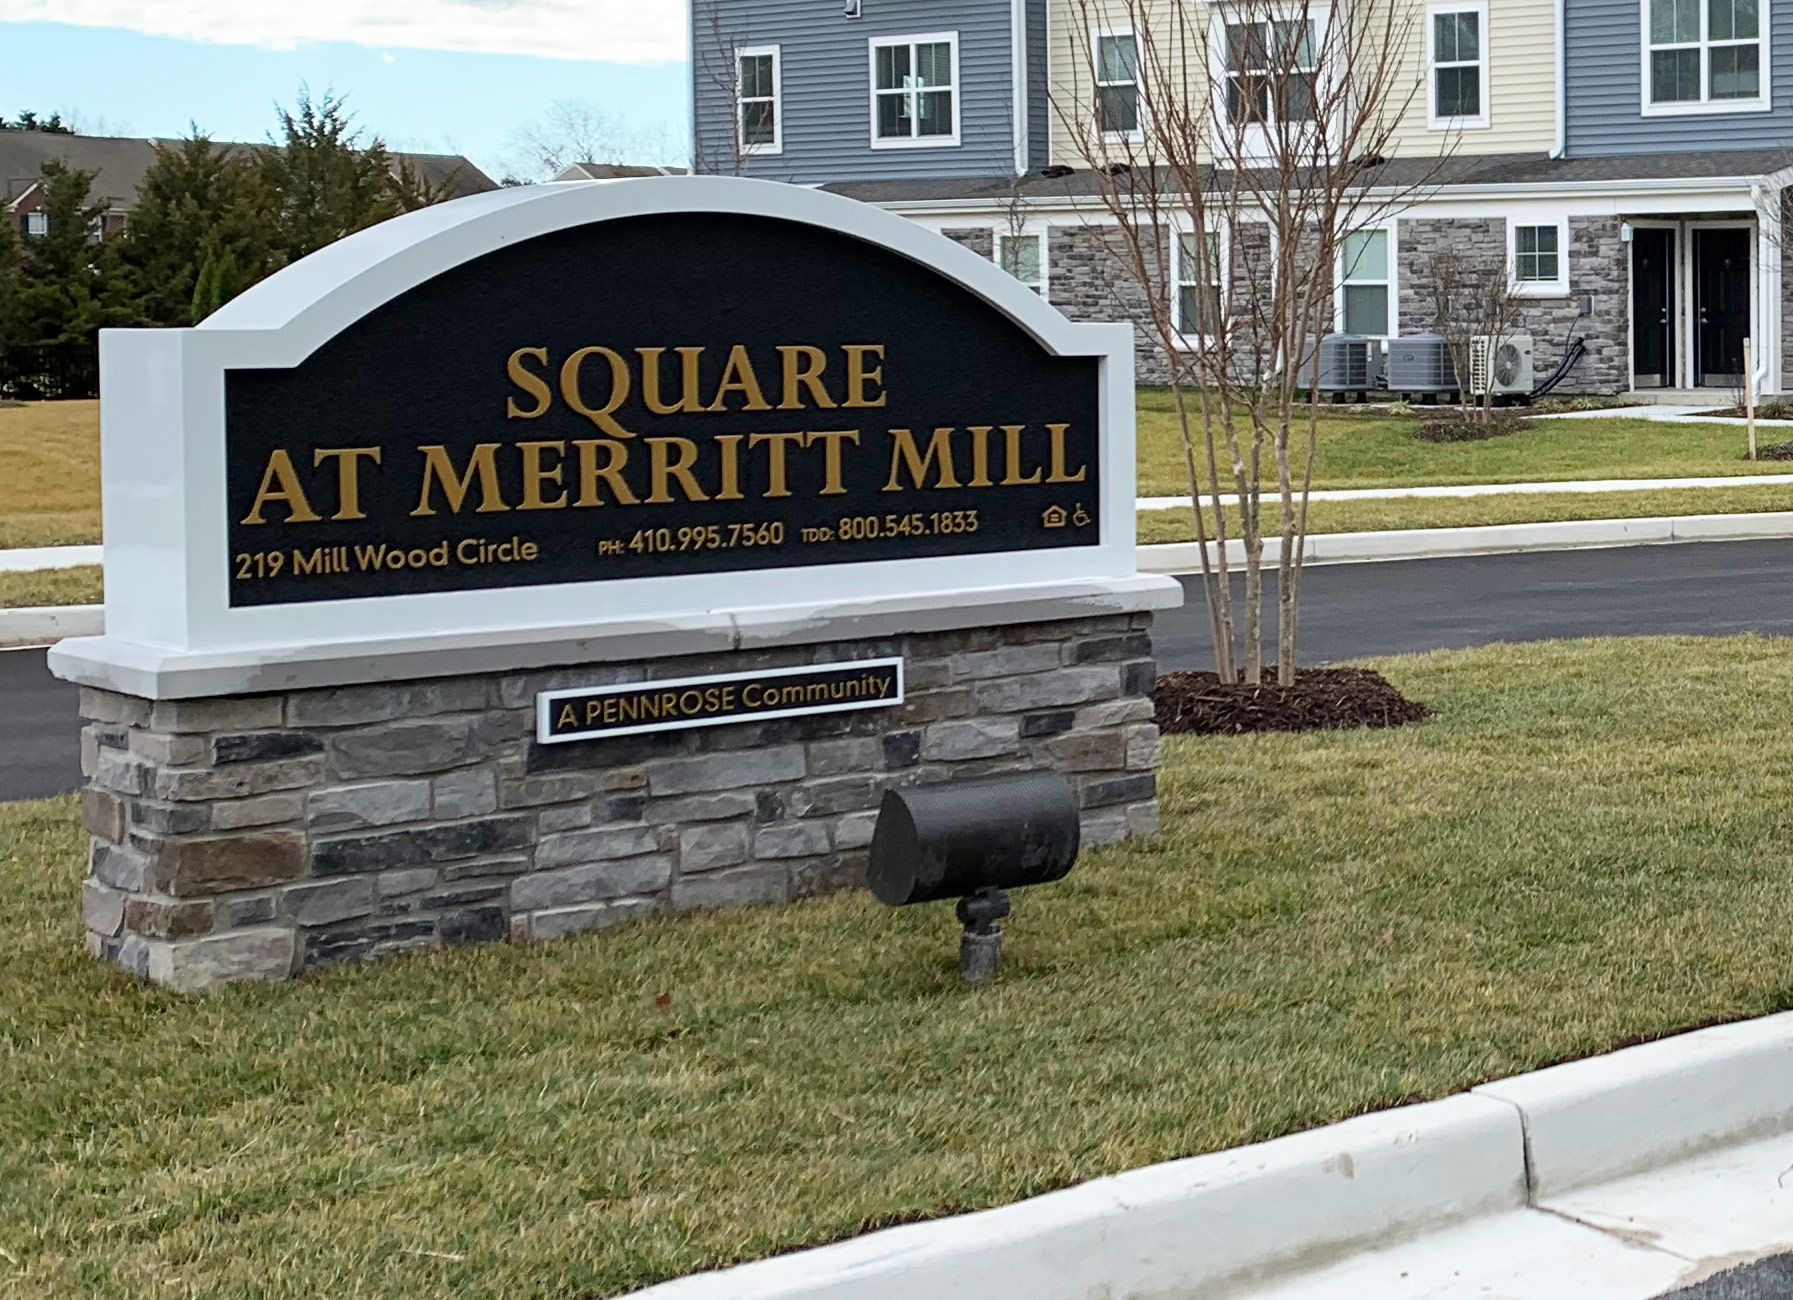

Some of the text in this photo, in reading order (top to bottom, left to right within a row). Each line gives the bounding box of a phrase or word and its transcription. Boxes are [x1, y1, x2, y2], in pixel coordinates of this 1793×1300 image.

[507, 344, 887, 438] SQUARE
[240, 423, 1087, 525] AT MERRITT MILL
[598, 521, 786, 556] PH: 410.995.7560
[801, 509, 980, 544] TDD: 800.545.1833
[235, 536, 539, 580] 219 Mill Wood Circle
[557, 674, 892, 729] A PENNROSE Community
